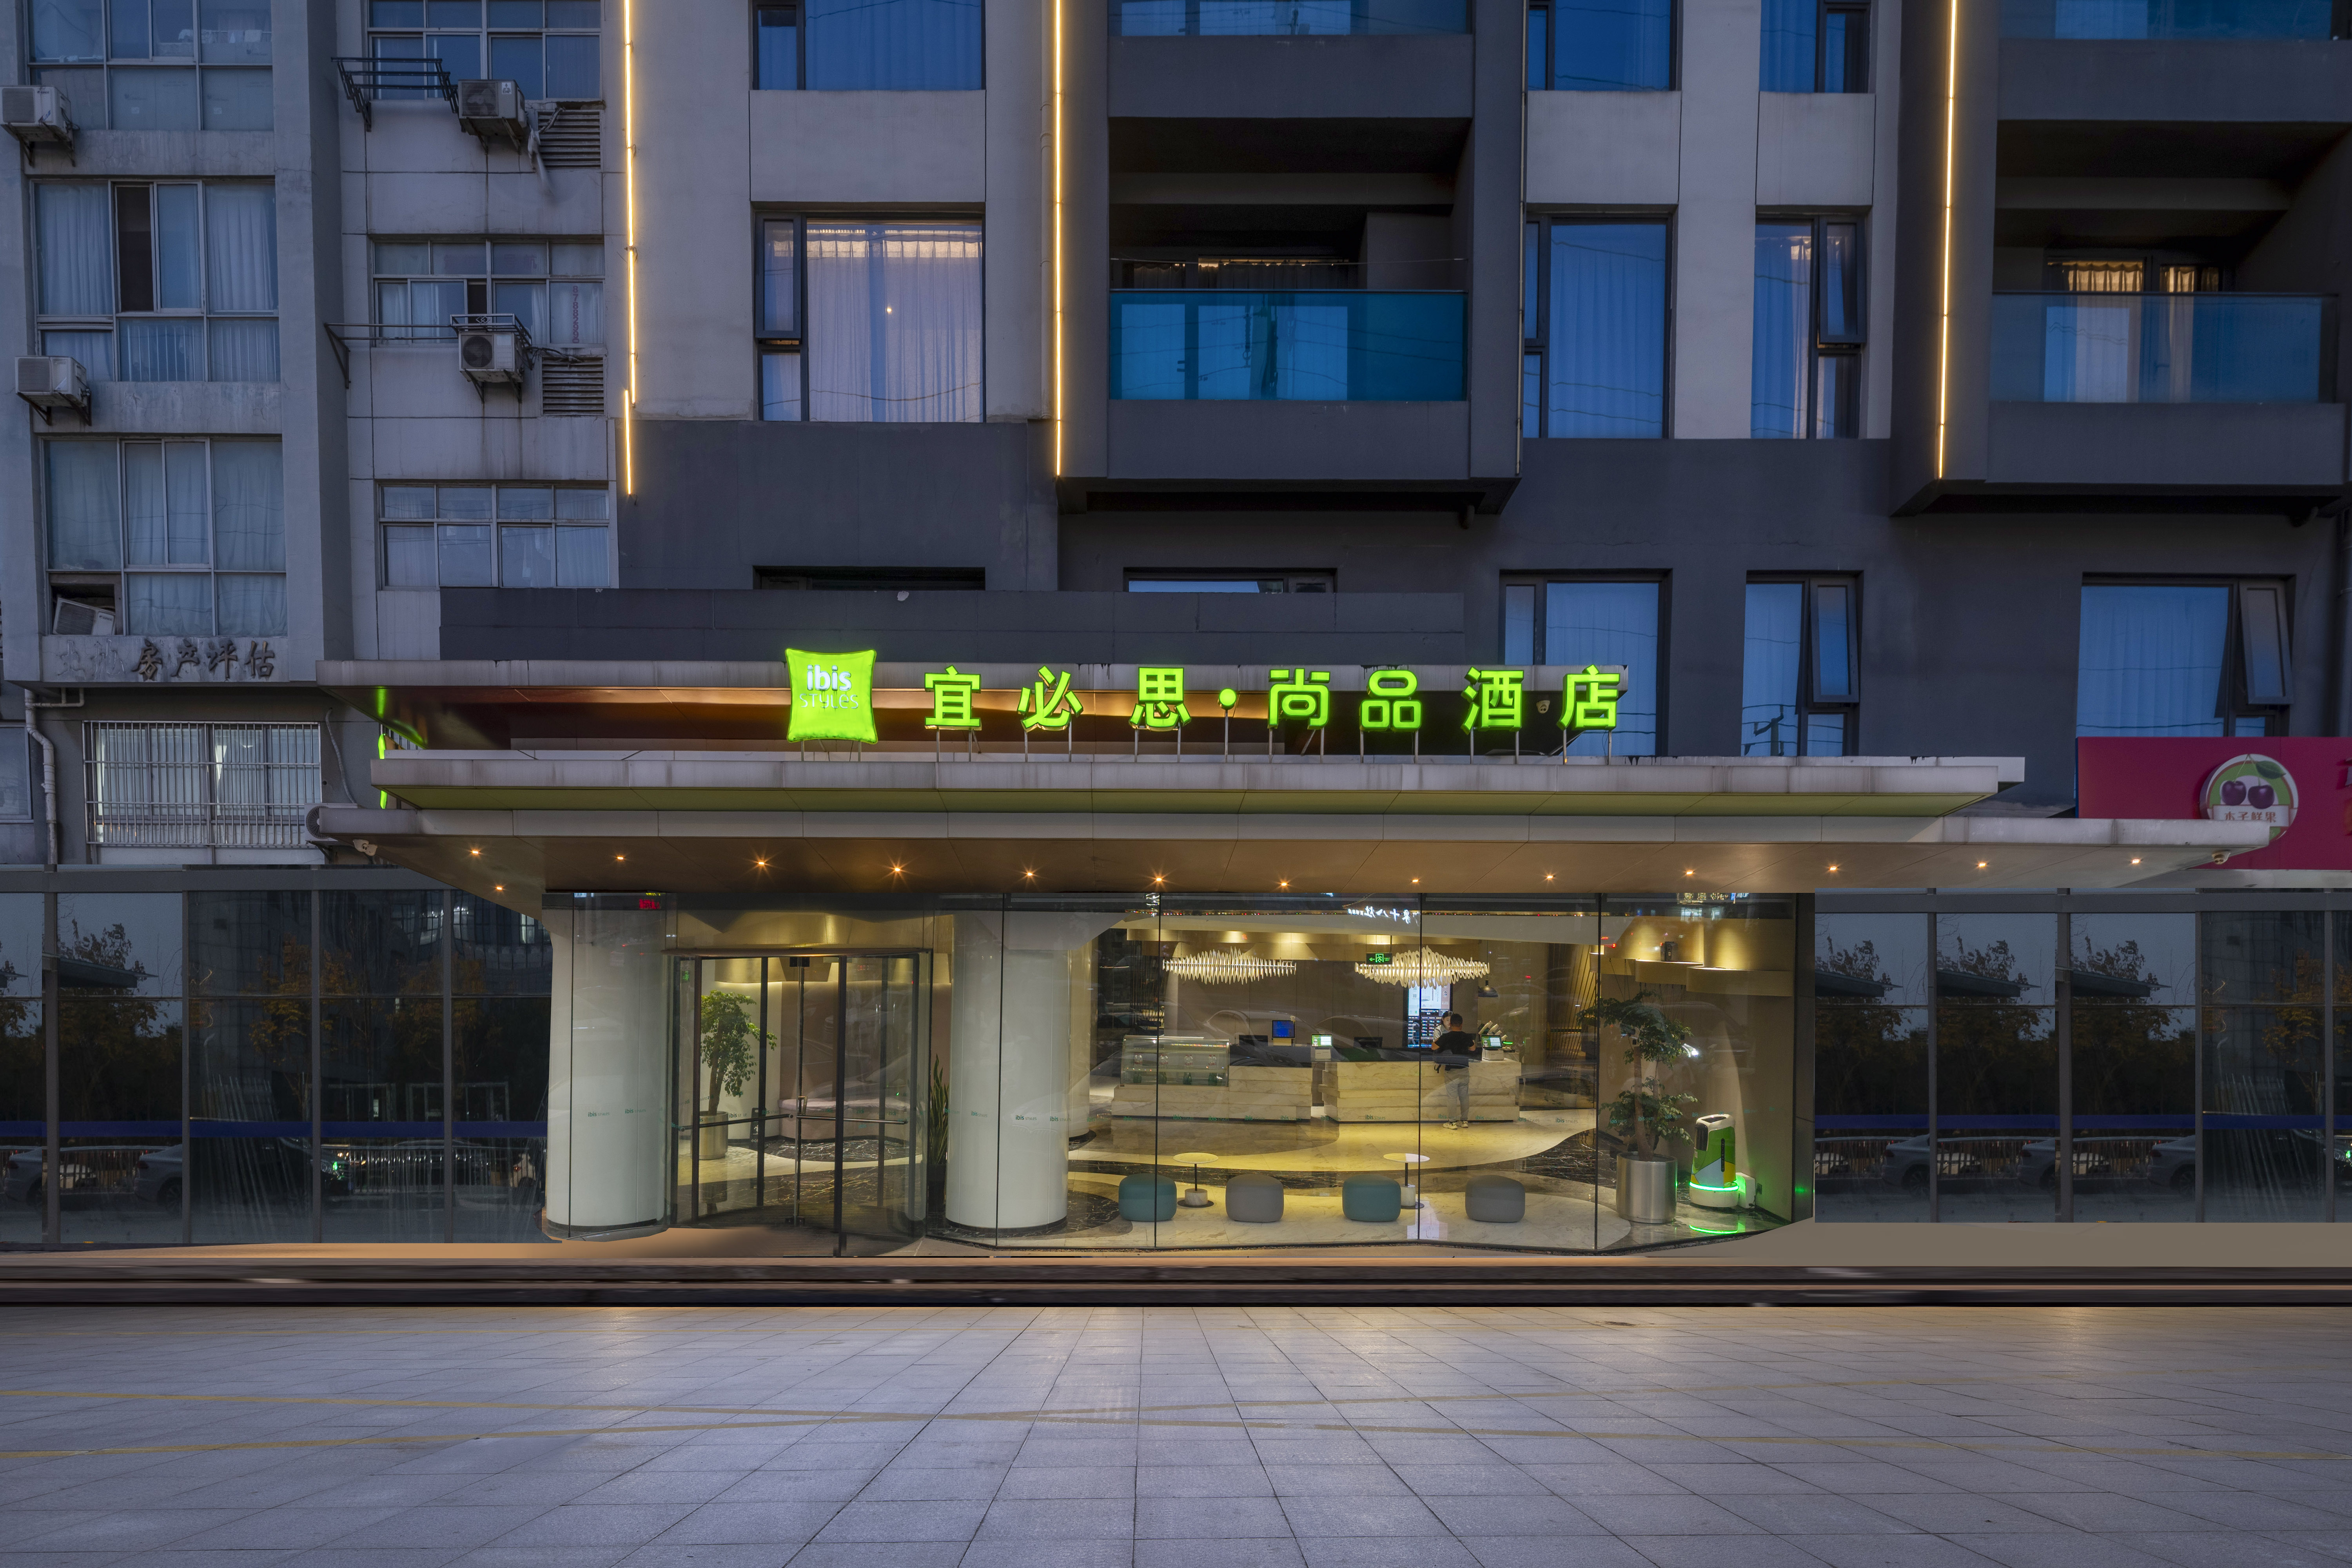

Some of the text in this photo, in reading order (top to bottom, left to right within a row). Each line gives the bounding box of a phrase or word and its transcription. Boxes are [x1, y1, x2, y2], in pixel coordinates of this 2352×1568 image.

[807, 664, 852, 691] ibis
[2225, 811, 2277, 823] 木子鲜果
